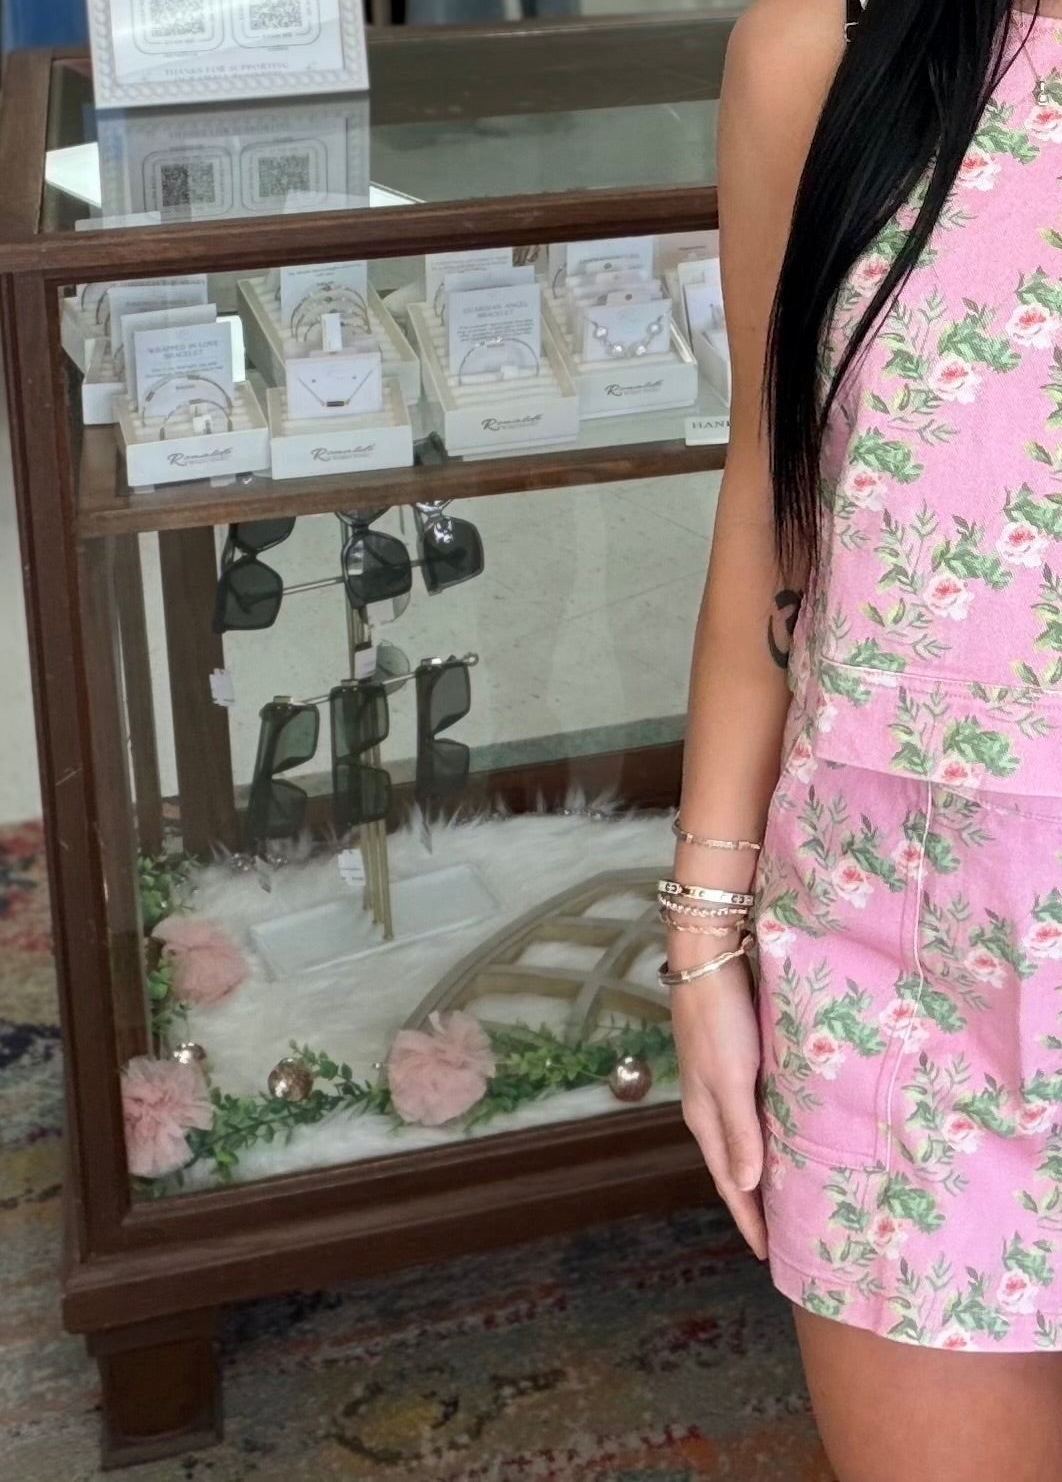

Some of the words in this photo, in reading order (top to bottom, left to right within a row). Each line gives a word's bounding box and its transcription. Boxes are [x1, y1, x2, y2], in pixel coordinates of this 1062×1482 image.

[165, 66, 204, 76] THANKS
[206, 64, 225, 73] FOR
[228, 61, 289, 72] SUPPORTING
[504, 301, 528, 309] ANGEL
